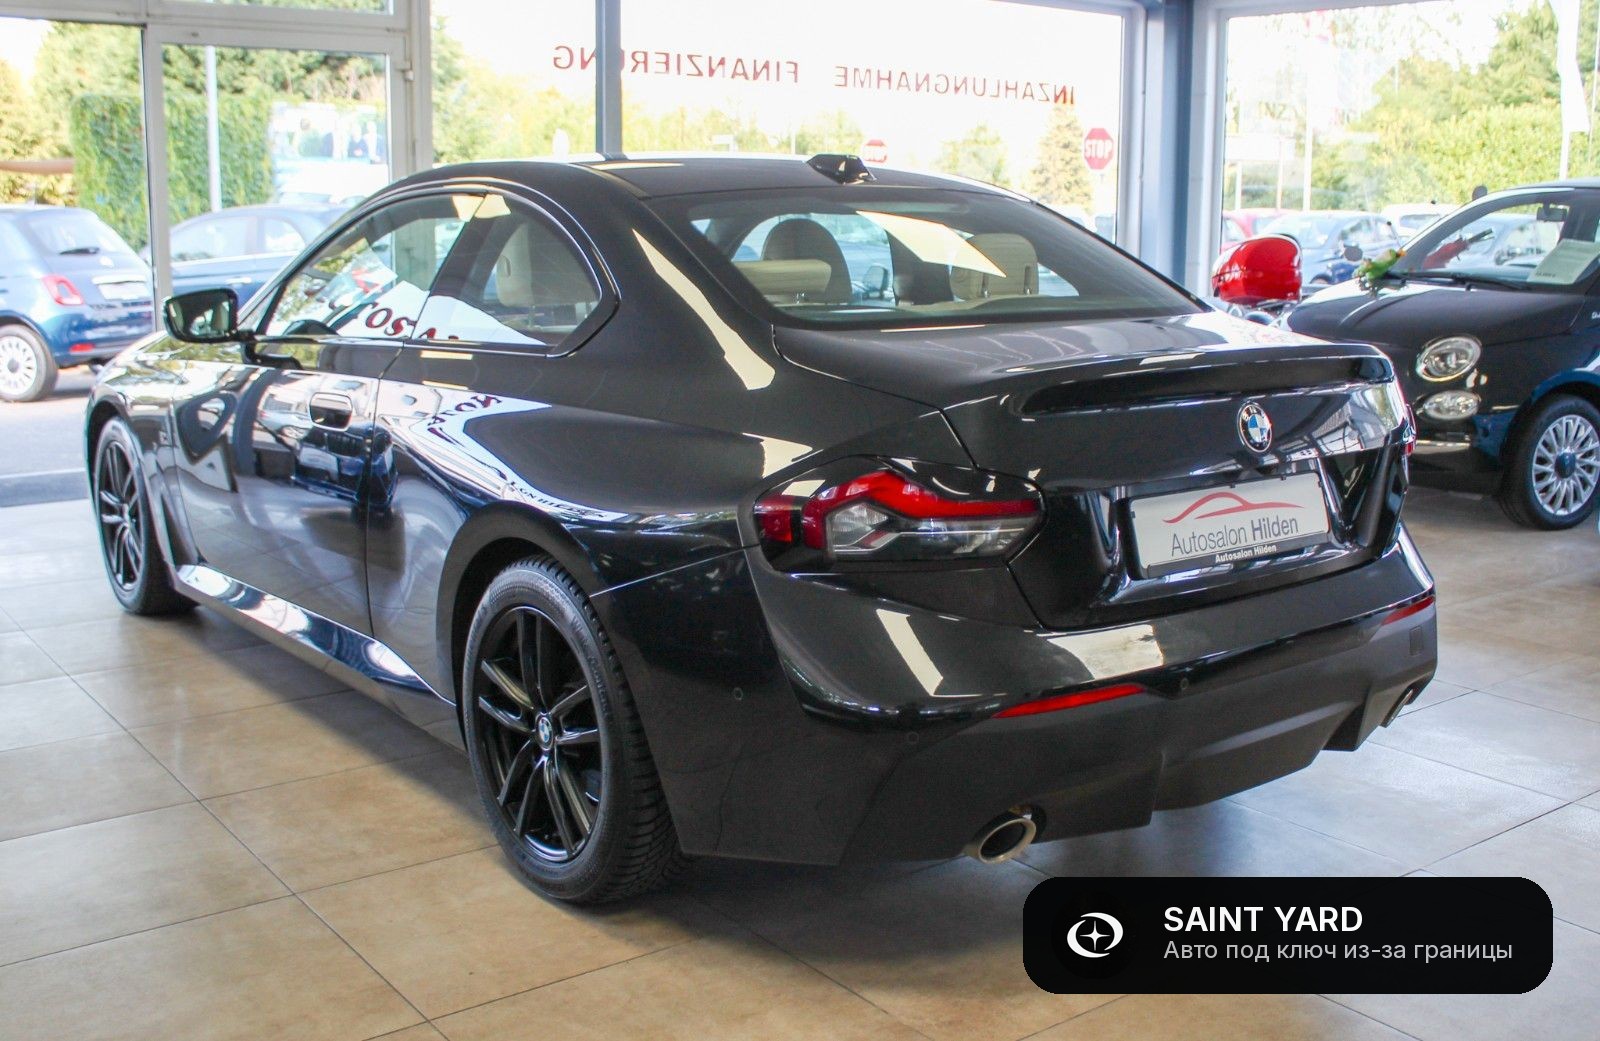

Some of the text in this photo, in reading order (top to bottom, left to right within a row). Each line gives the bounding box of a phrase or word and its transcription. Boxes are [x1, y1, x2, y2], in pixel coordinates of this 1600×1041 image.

[1085, 139, 1113, 160] STOP
[1171, 517, 1299, 556] Autosalon Hilden
[1215, 544, 1277, 563] Autosalon Hilden
